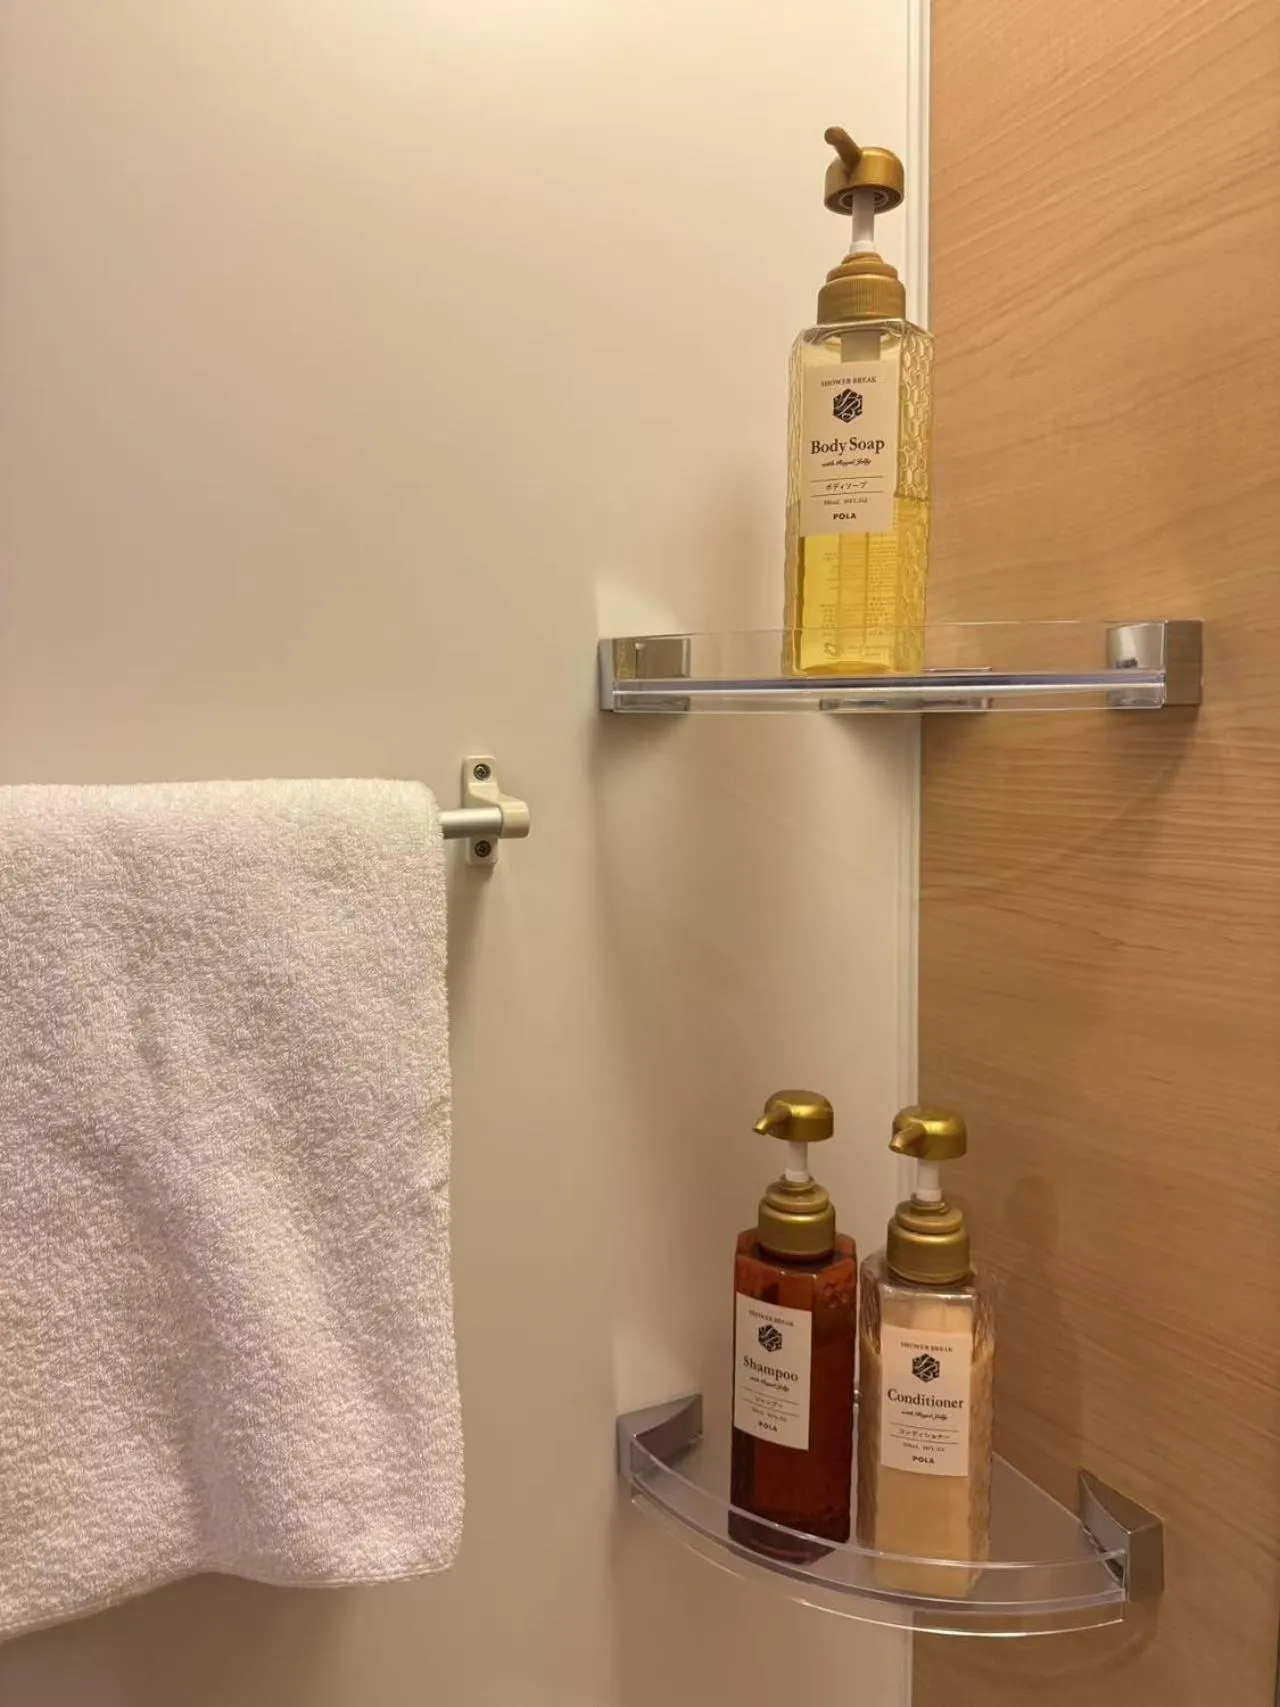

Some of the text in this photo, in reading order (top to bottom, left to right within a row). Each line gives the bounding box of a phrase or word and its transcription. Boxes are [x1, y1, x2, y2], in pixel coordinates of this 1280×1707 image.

[853, 376, 877, 384] BREAK
[811, 436, 885, 456] Body Soap
[832, 512, 857, 520] POLA
[743, 1355, 799, 1382] Shampoo
[887, 1388, 965, 1409] Conditioner
[758, 1420, 778, 1432] POLA
[911, 1455, 936, 1465] POLA
